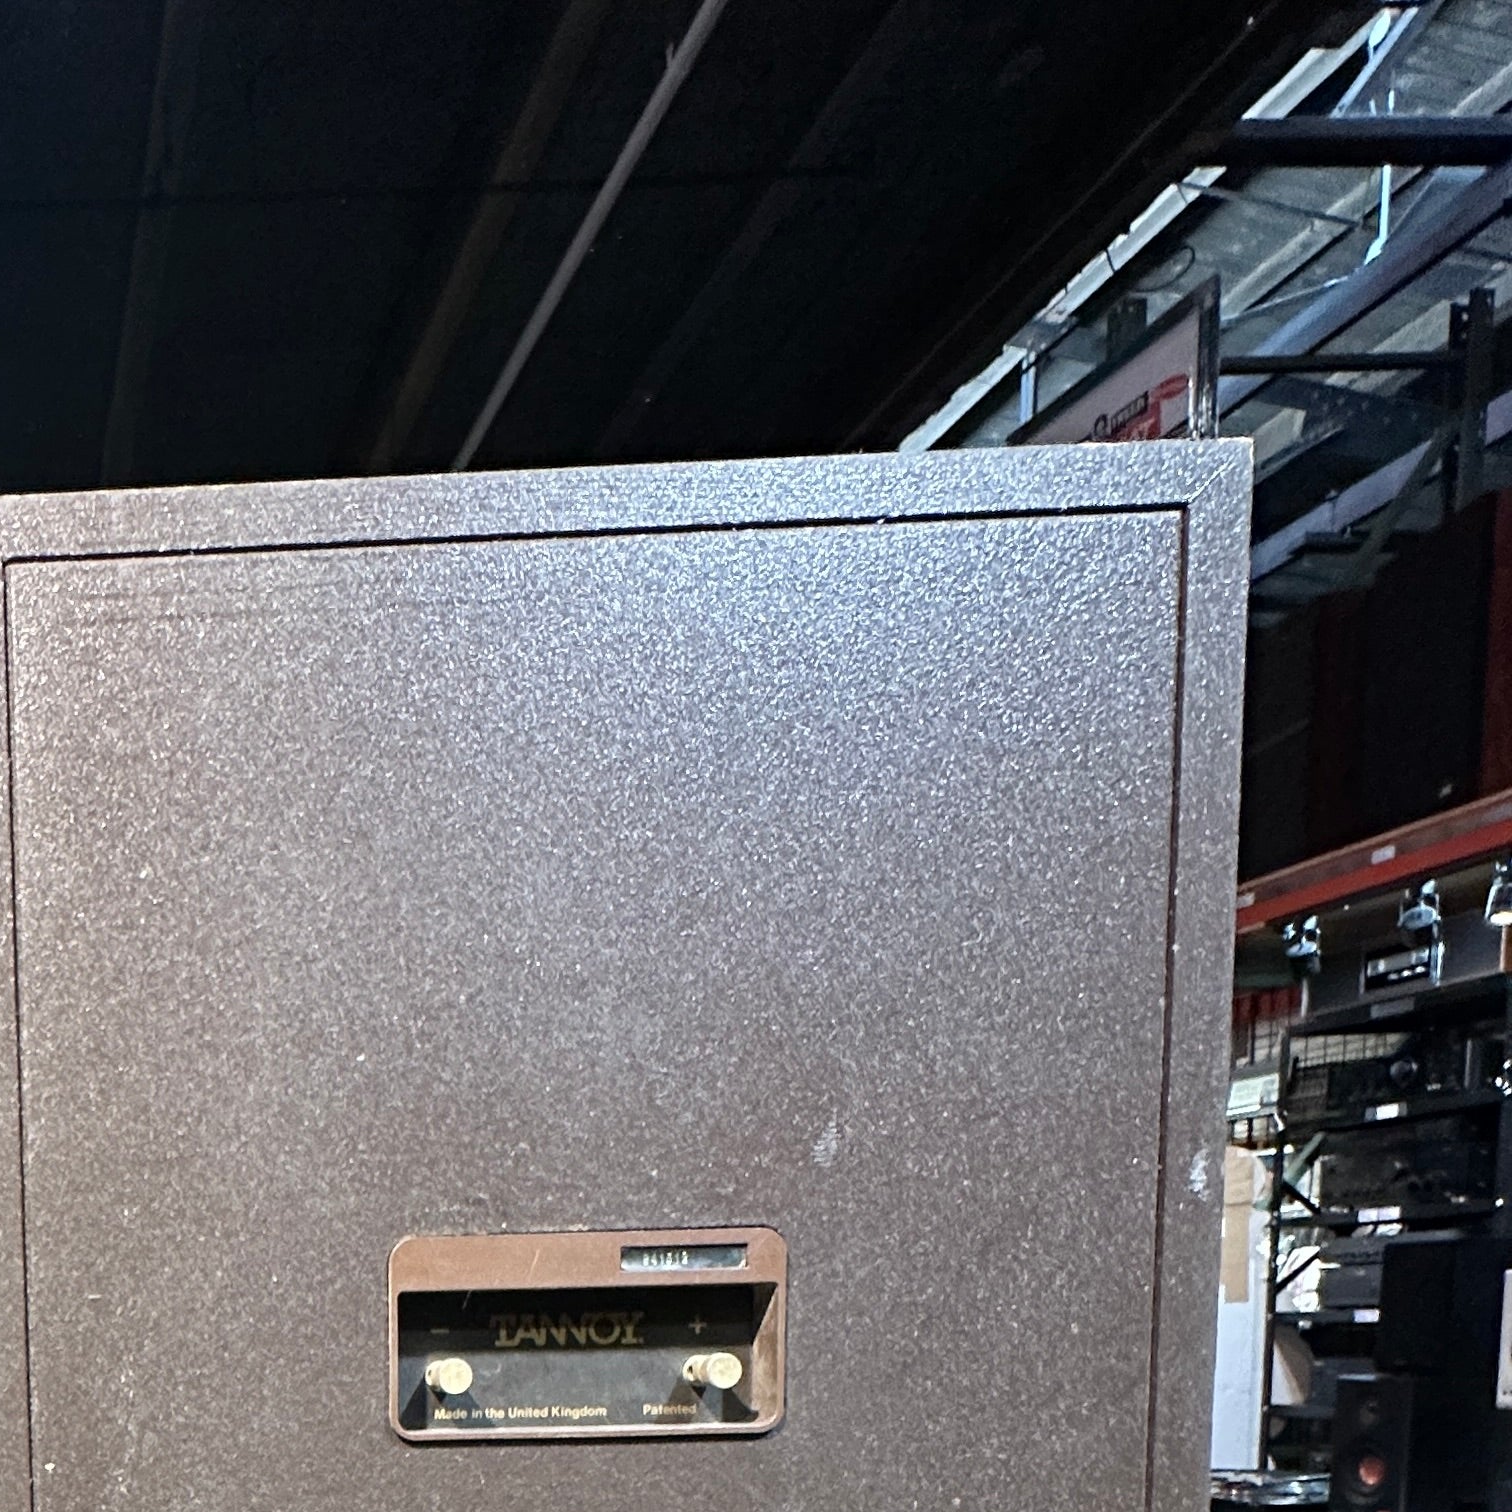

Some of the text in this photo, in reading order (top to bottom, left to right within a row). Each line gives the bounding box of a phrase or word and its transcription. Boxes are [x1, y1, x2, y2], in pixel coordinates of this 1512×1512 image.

[489, 1311, 645, 1347] TANNOY
[433, 1405, 608, 1420] Made in the United Kingdom
[642, 1403, 697, 1416] Patented
